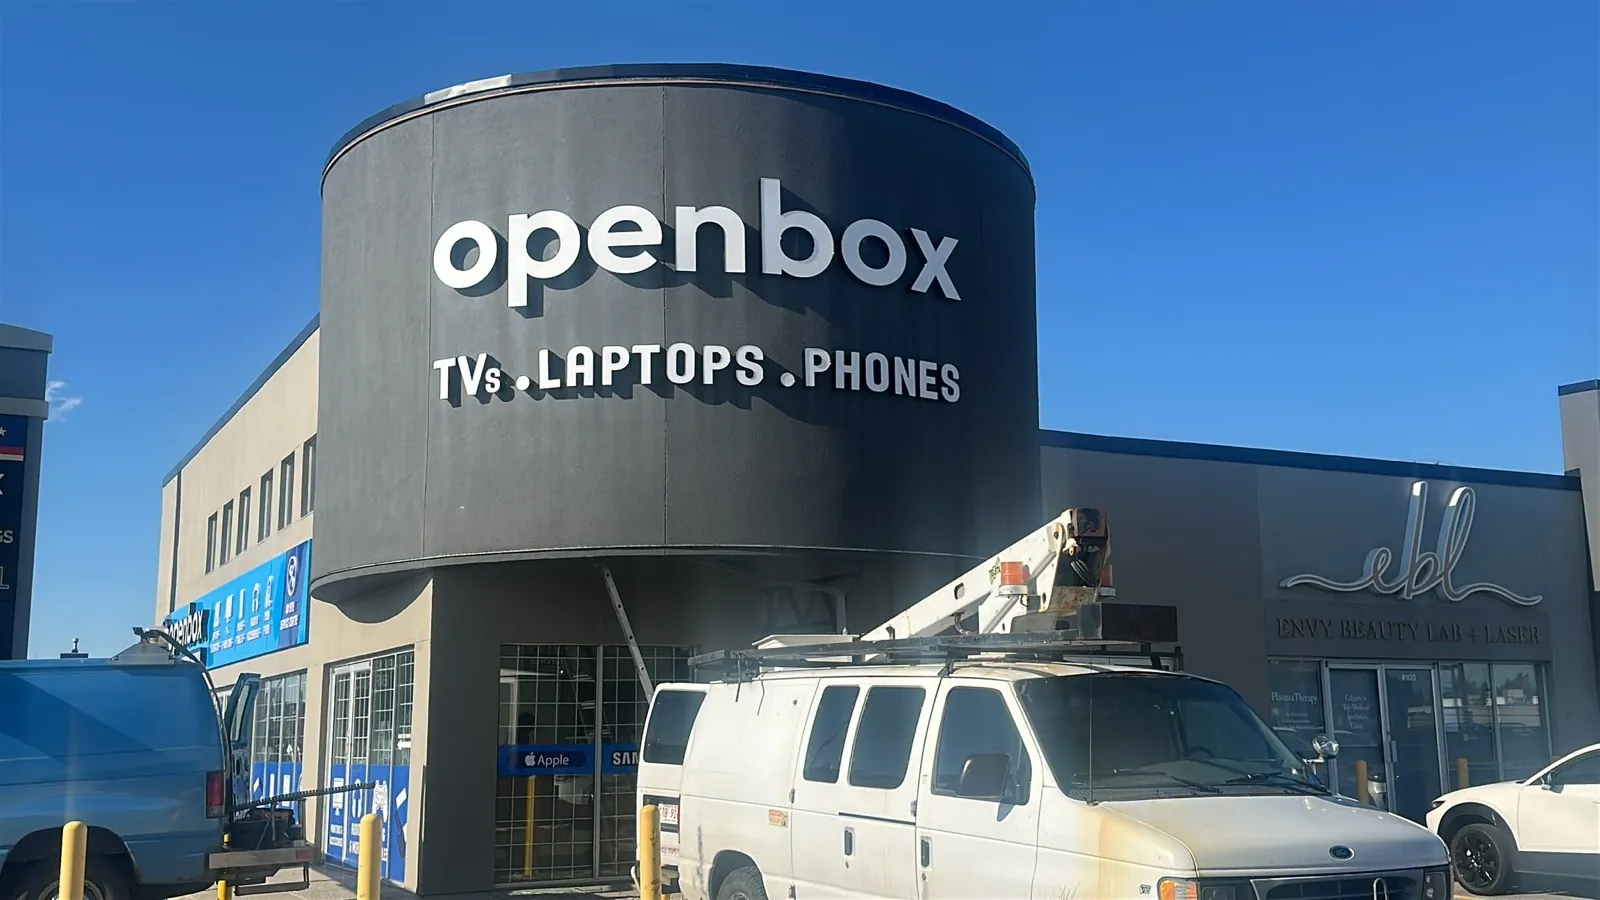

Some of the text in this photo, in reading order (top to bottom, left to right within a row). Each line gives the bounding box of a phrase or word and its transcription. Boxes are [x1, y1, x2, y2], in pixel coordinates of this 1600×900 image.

[433, 177, 961, 308] openbox
[433, 353, 501, 400] TVs
[1276, 617, 1332, 640] ENVY
[1340, 620, 1418, 642] BEAUTY
[1427, 623, 1462, 643] LAB
[1485, 624, 1541, 645] LASER
[537, 754, 570, 768] Apple
